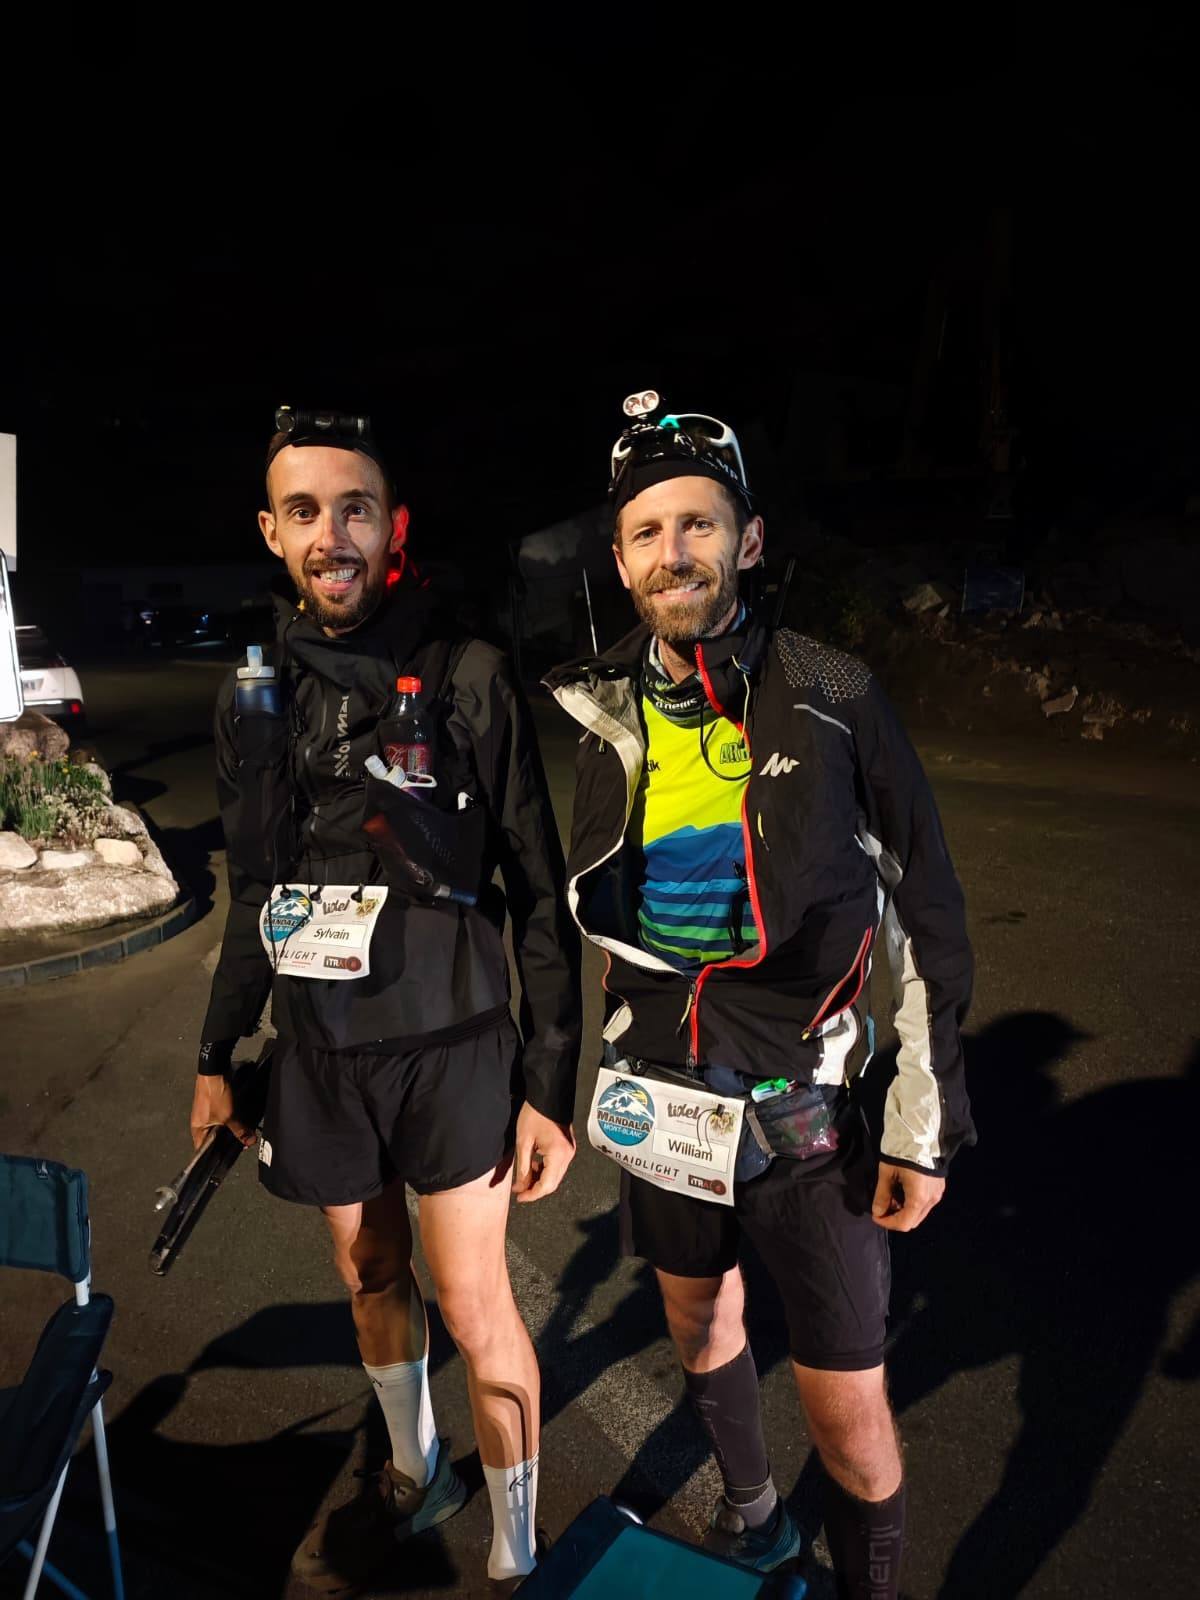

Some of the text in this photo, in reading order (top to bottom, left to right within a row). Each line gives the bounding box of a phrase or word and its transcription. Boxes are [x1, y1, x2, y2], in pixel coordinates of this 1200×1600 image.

[313, 927, 350, 941] Sylvain
[597, 1110, 651, 1133] MANDALA
[603, 1123, 643, 1139] MONT-BLANC
[668, 1138, 713, 1162] William
[615, 1151, 680, 1178] RAIDLIGHT
